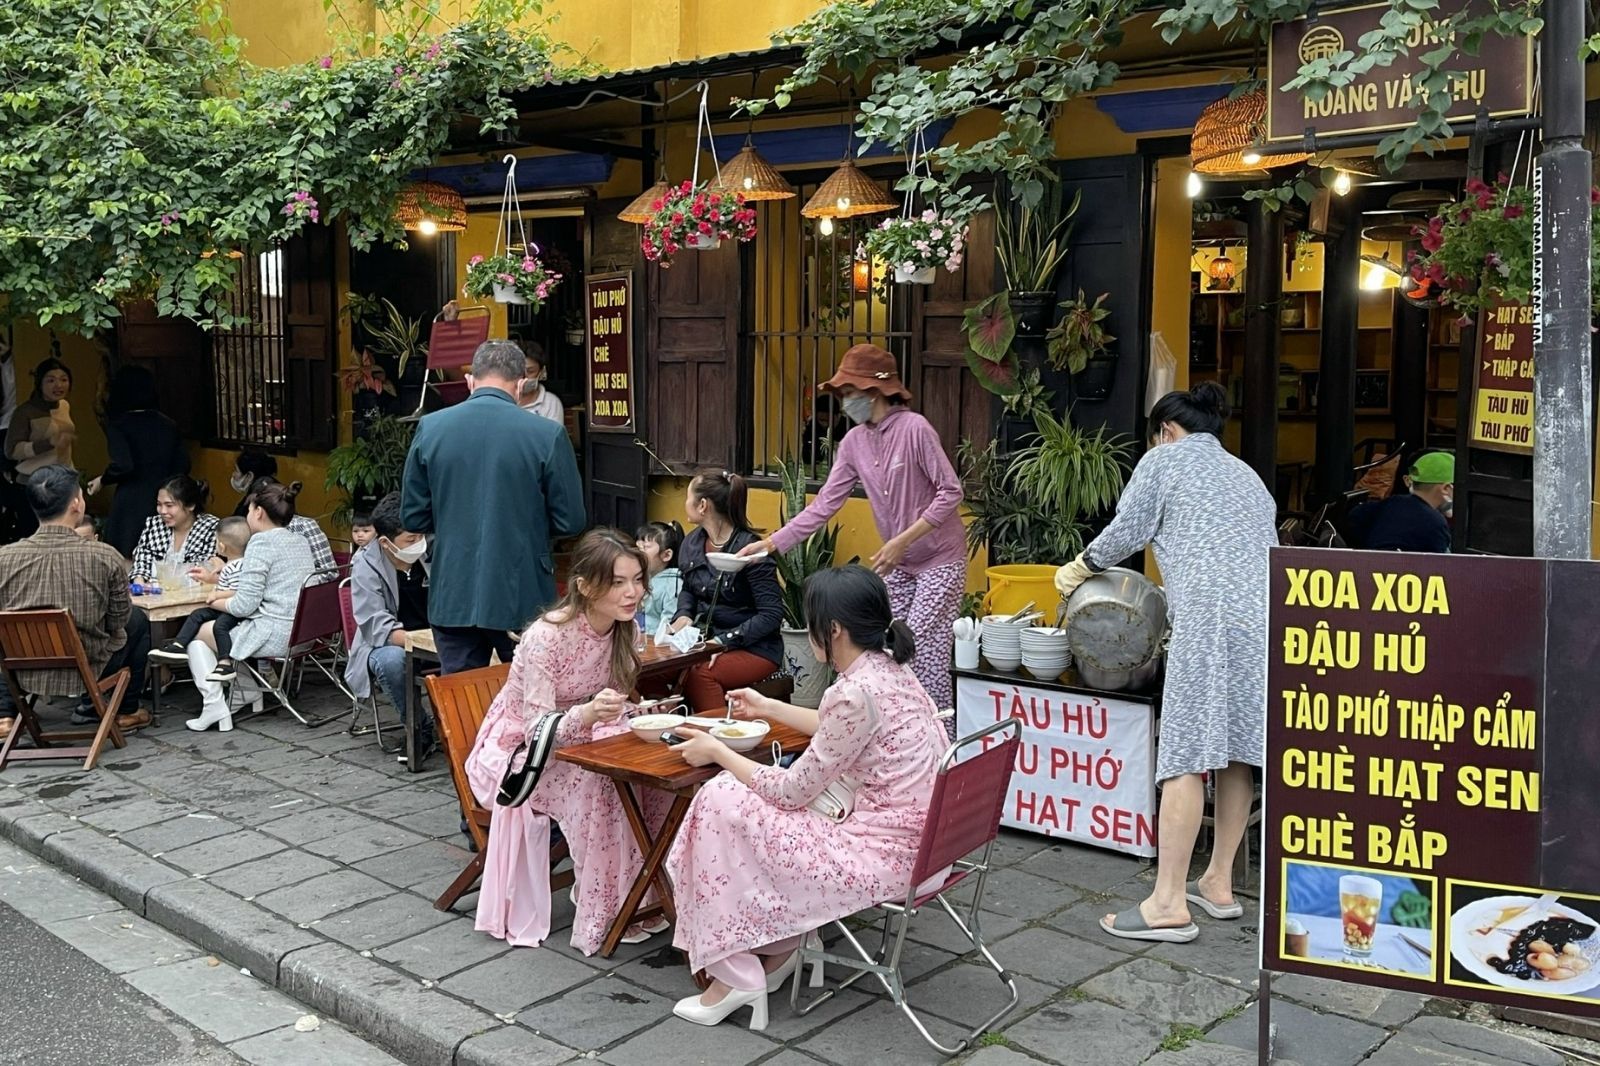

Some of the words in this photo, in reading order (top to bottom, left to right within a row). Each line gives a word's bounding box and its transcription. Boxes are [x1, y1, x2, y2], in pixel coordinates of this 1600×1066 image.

[1447, 69, 1486, 106] HỤ
[609, 285, 626, 307] PHỚ
[593, 315, 609, 339] ĐẬU
[611, 311, 622, 334] HỦ
[1496, 306, 1518, 327] HẠT
[1519, 306, 1534, 324] SE
[594, 342, 609, 362] CHÈ
[1494, 328, 1515, 350] BẮP
[1492, 356, 1518, 380] THẬP
[594, 373, 609, 393] HẠT
[611, 373, 627, 389] SEN
[595, 400, 610, 417] XOA
[612, 400, 628, 417] XOA
[1487, 393, 1508, 414] TÀU
[1511, 395, 1529, 415] HỦ
[1504, 423, 1532, 443] PHỚ
[1285, 567, 1360, 610] XOA
[1371, 572, 1450, 615] XOA
[1283, 620, 1361, 675] ĐẬU
[1374, 621, 1426, 674] HỦ
[989, 687, 1050, 730] TÀU
[1062, 698, 1107, 739] HỦ
[1282, 683, 1329, 731] TÀO
[1337, 689, 1390, 737] PHỚ
[1396, 694, 1465, 750] THẬP
[1473, 691, 1537, 750] CẨM
[980, 731, 1038, 775] TU
[1051, 748, 1123, 790] PHỚ
[1282, 745, 1355, 793] CHÈ
[1369, 756, 1444, 808] HẠT
[1456, 765, 1540, 812] SEN
[1015, 789, 1081, 836] HẠT
[1089, 805, 1156, 848] SEN
[1281, 812, 1355, 860] CHÈ
[1368, 813, 1448, 870] BẮP
